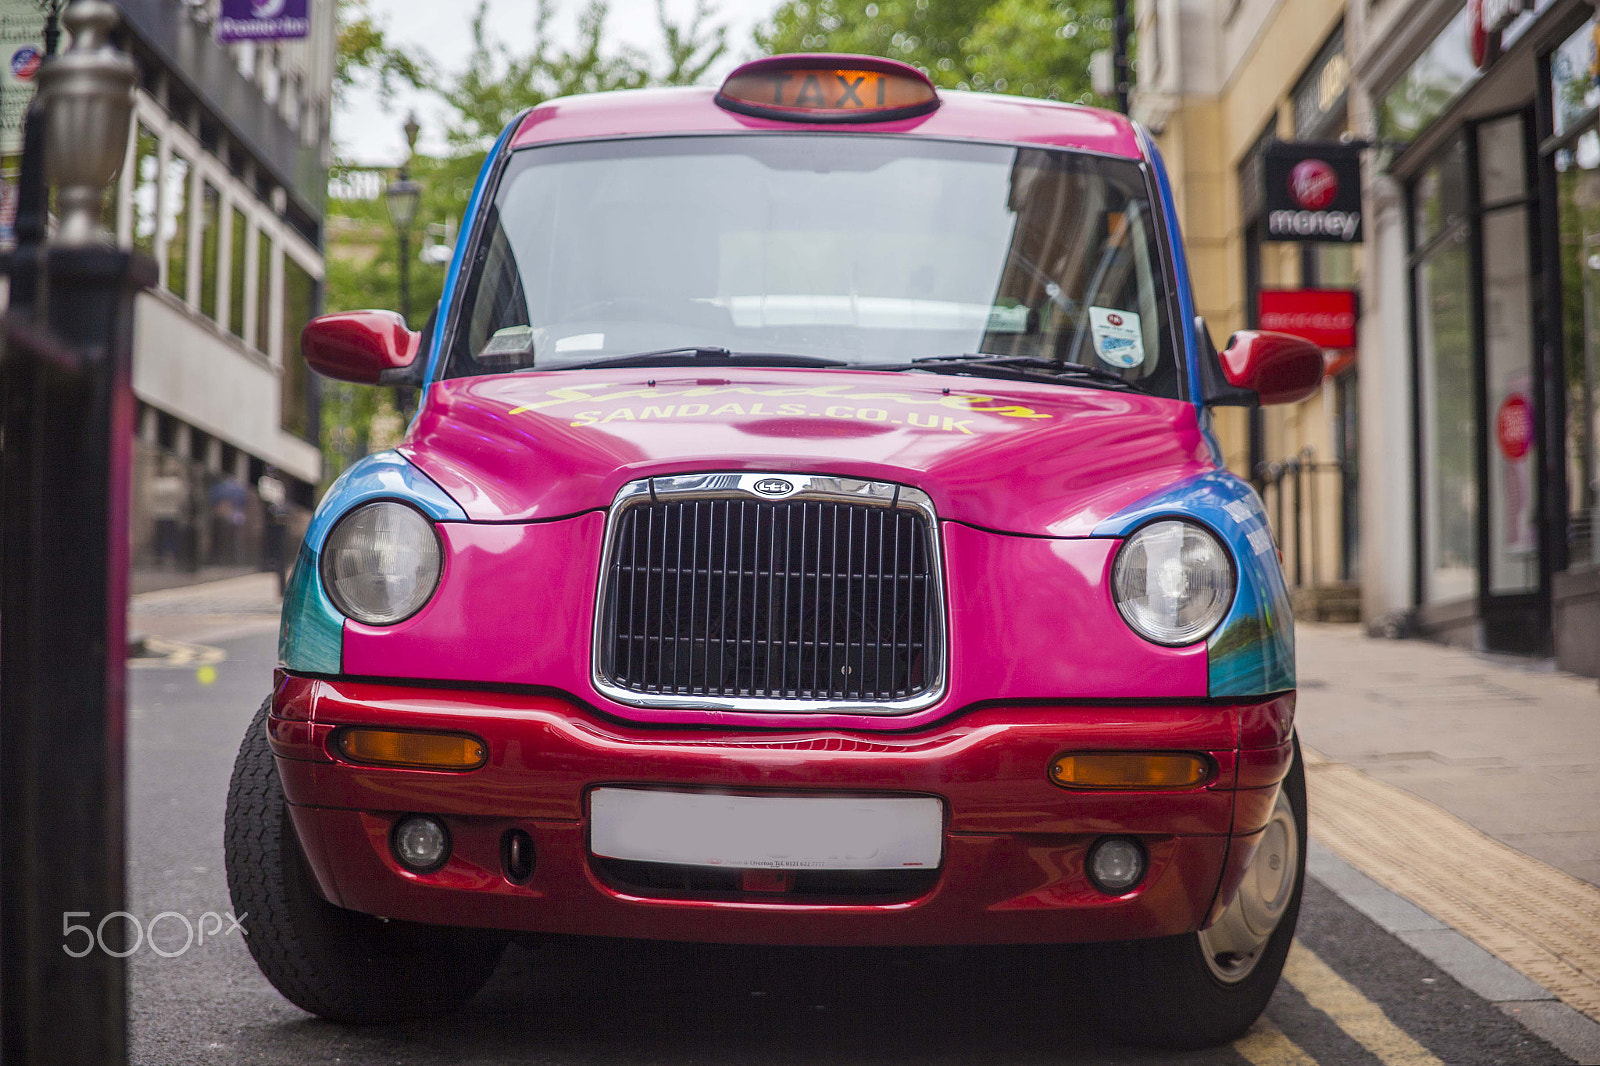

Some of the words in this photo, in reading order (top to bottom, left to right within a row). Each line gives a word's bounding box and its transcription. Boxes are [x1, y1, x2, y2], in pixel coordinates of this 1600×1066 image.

[768, 74, 886, 107] TAXI
[1269, 209, 1361, 241] money
[570, 402, 976, 436] SANDALS.CO.UK
